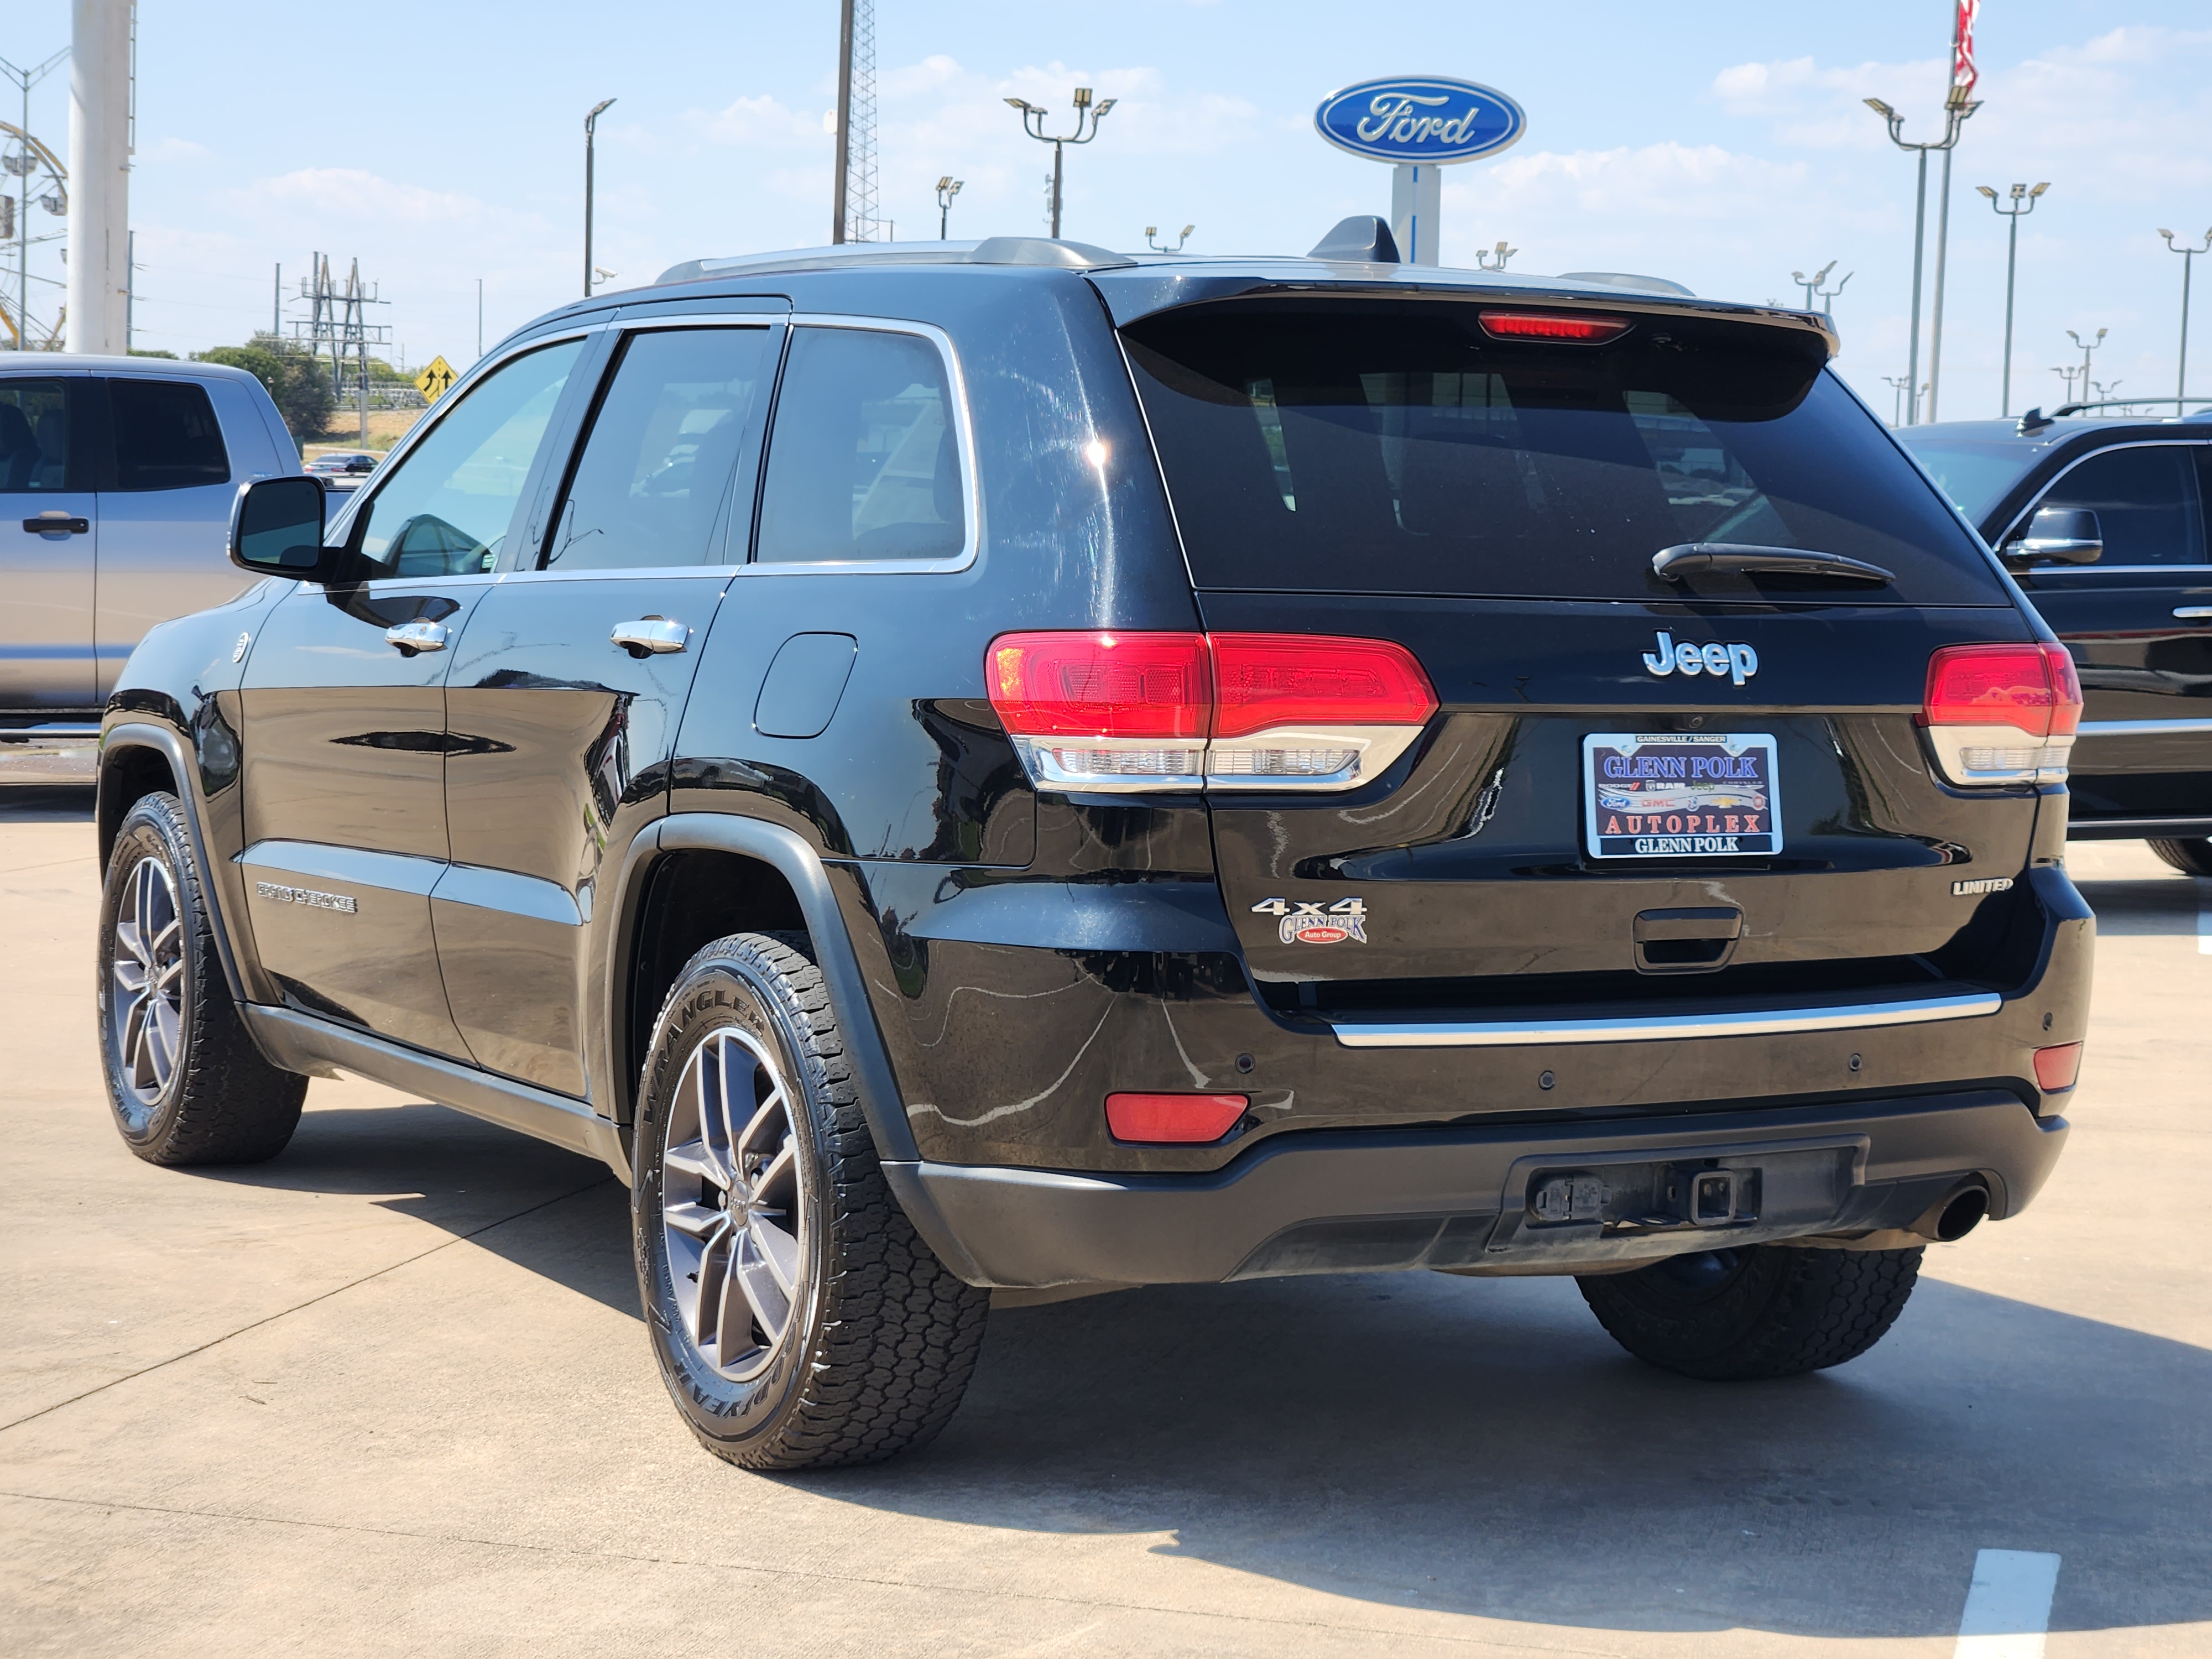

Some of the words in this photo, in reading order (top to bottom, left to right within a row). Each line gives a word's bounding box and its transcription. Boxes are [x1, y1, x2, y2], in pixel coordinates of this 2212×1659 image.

[1357, 92, 1480, 144] Ford
[1642, 631, 1759, 686] Jeep
[1604, 757, 1687, 778] GLENN
[1691, 757, 1759, 778] POLK
[1691, 780, 1714, 792] Jeep
[1606, 797, 1627, 807] Ford
[1641, 799, 1675, 807] GMC
[1605, 815, 1760, 834] AUTOPLEX
[1635, 838, 1692, 853] GLENN
[1694, 837, 1739, 852] POLK
[1952, 878, 2013, 896] LIMITED
[257, 881, 294, 902] GRAND
[293, 888, 358, 914] CHEROKEE
[1251, 898, 1368, 916] 4x4
[1281, 916, 1325, 941] GLENN
[1330, 916, 1365, 940] POLK
